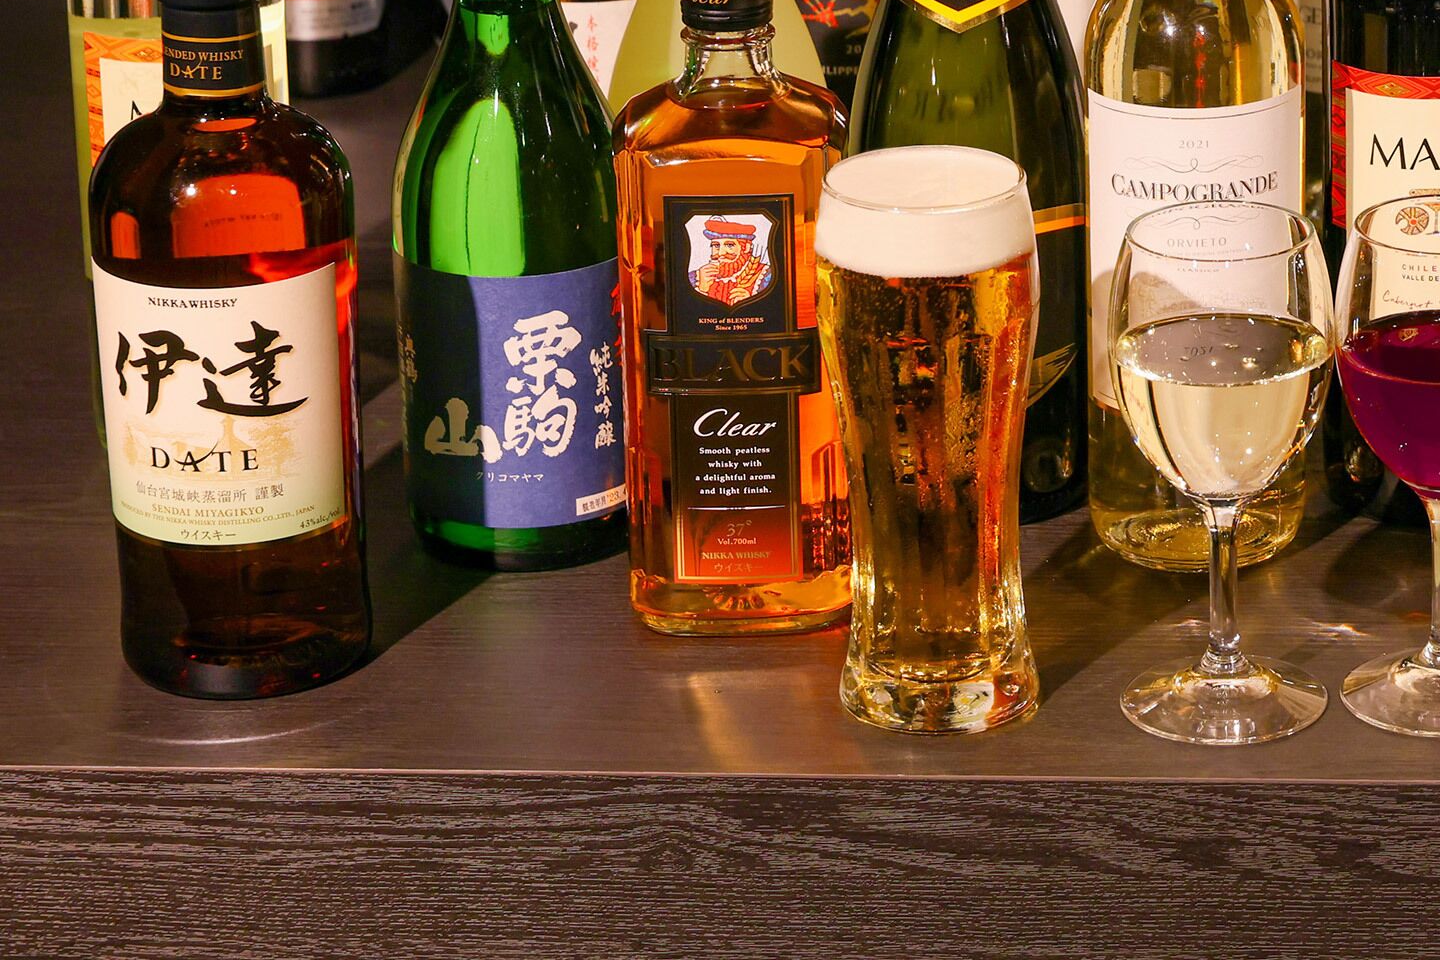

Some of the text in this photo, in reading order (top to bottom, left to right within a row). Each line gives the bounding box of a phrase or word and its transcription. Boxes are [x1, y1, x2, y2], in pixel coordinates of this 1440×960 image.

[198, 48, 245, 63] WHISKY
[170, 62, 223, 81] DATE
[1177, 139, 1210, 149] 2021
[1111, 171, 1279, 202] CAMPOGRANDE
[1166, 236, 1227, 249] ORVIETO
[1402, 263, 1437, 272] CHILE
[1402, 274, 1426, 282] VALLE
[698, 317, 718, 325] KING
[726, 316, 764, 325] BLENDERS
[115, 320, 309, 417] 伊達
[652, 344, 811, 382] BLACK
[692, 408, 777, 438] Clear
[151, 441, 260, 473] DATE
[699, 446, 771, 456] Smooth peatless
[707, 460, 763, 470] whisky with
[475, 471, 545, 483] クリコマヤマ
[703, 473, 747, 484] delightful
[699, 486, 773, 496] and light finish.
[151, 503, 265, 518] SENDAI MIYAGIKYO
[166, 514, 187, 525] NIKKA
[187, 516, 217, 526] WHISKY
[217, 516, 262, 527] DISTILLING
[295, 504, 315, 518] JAPAN
[180, 528, 237, 540] ウイスキー
[717, 538, 757, 546] Vol.700ml
[701, 551, 735, 560] NIKKA
